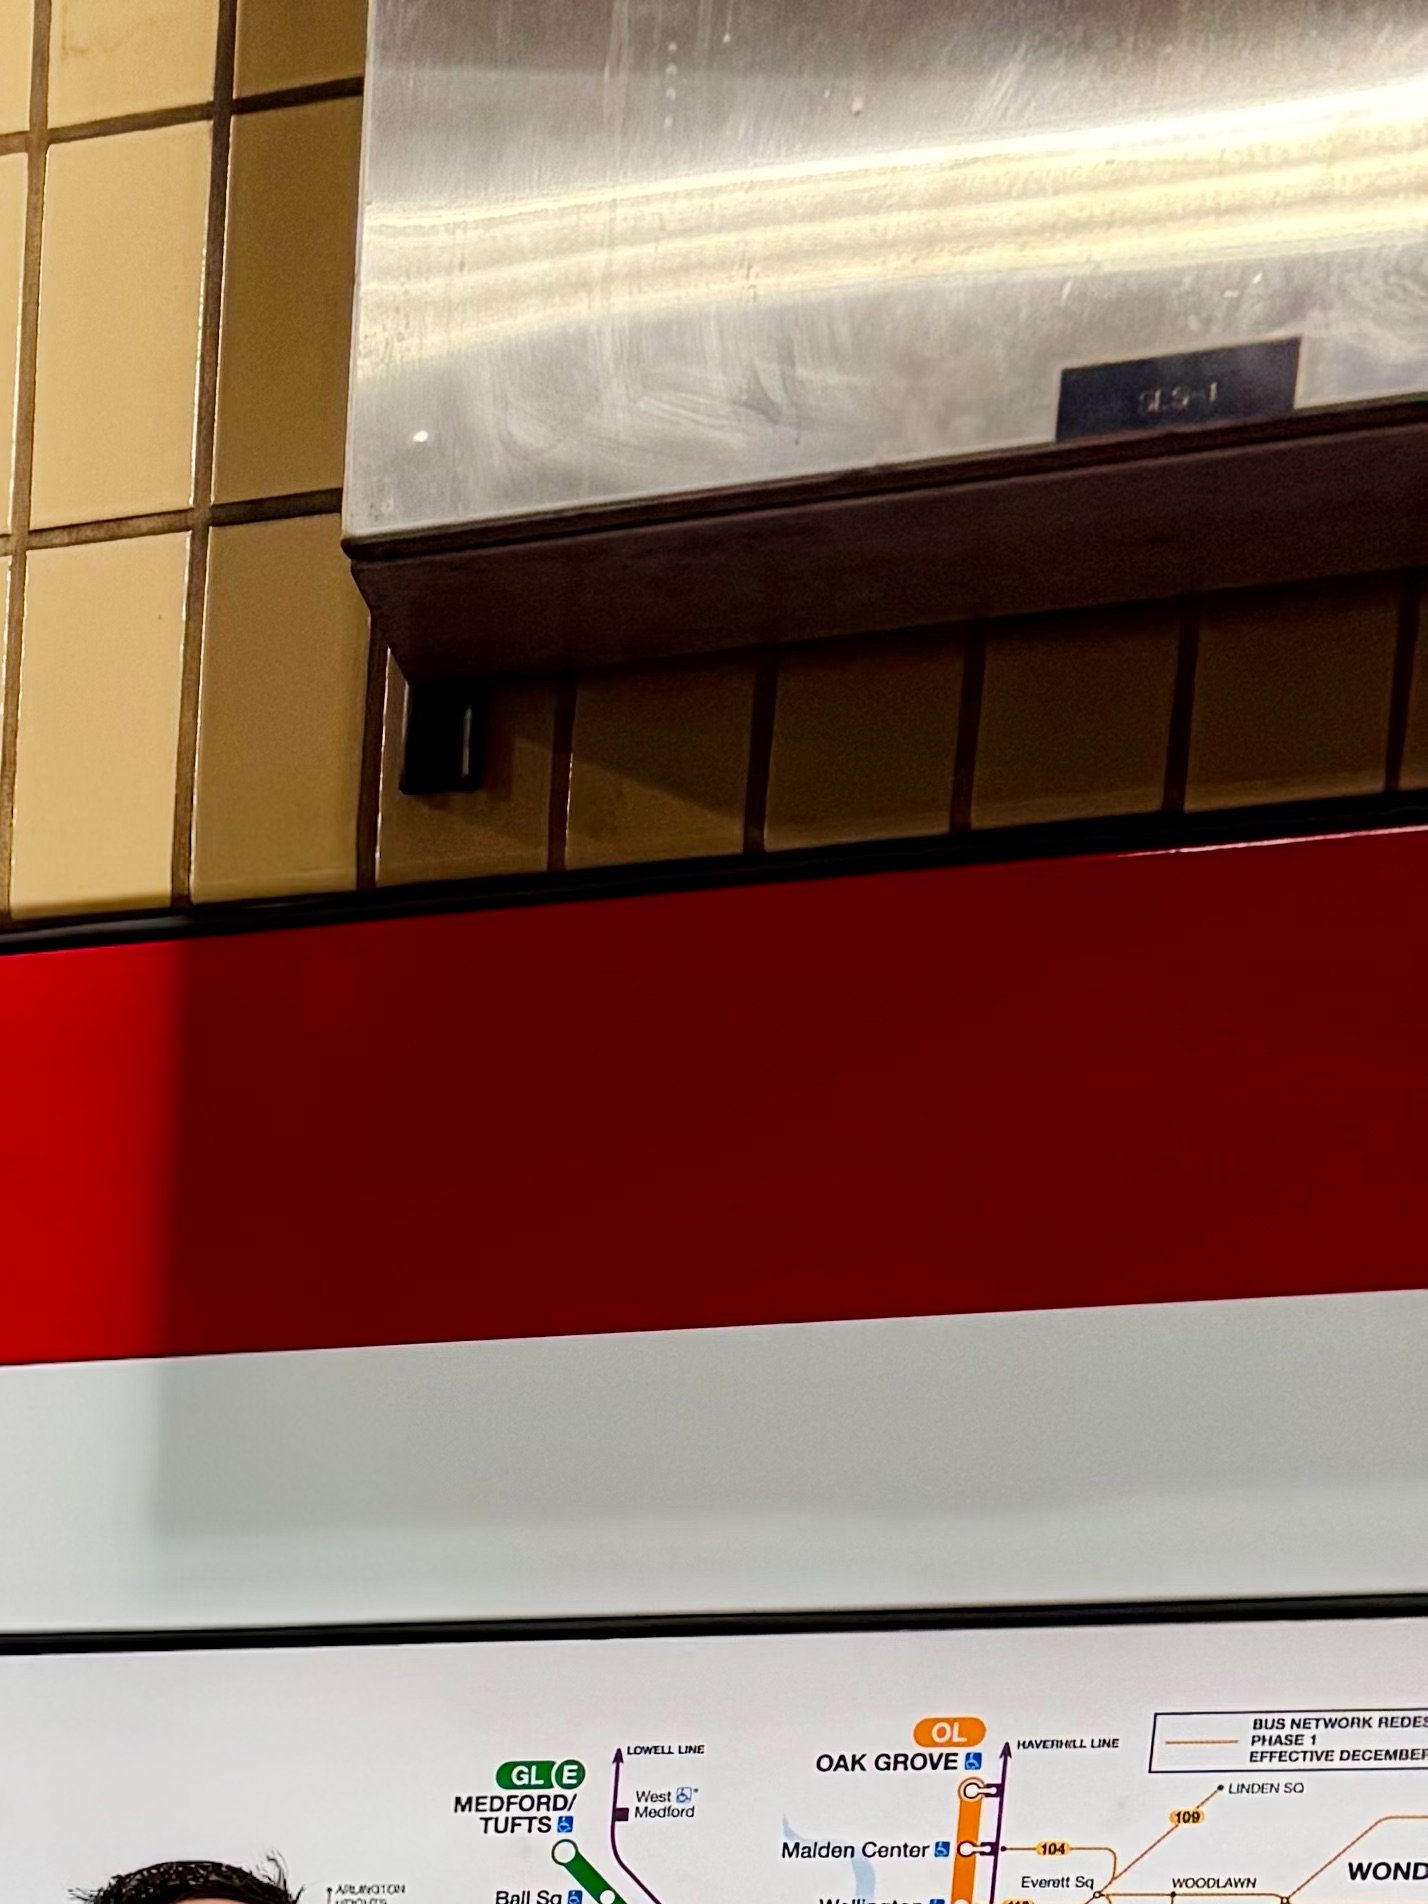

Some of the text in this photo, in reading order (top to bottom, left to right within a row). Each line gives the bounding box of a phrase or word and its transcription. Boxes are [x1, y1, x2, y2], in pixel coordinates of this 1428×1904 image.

[1253, 1717, 1372, 1730] BUS NETWORK
[932, 1723, 966, 1743] OL
[817, 1753, 958, 1772] OAK GROVE
[512, 1766, 544, 1785] GL
[454, 1794, 577, 1813] MEDFORD/
[480, 1816, 551, 1834] TUFTS
[1176, 1811, 1200, 1823] 109
[782, 1842, 930, 1858] Malden Center
